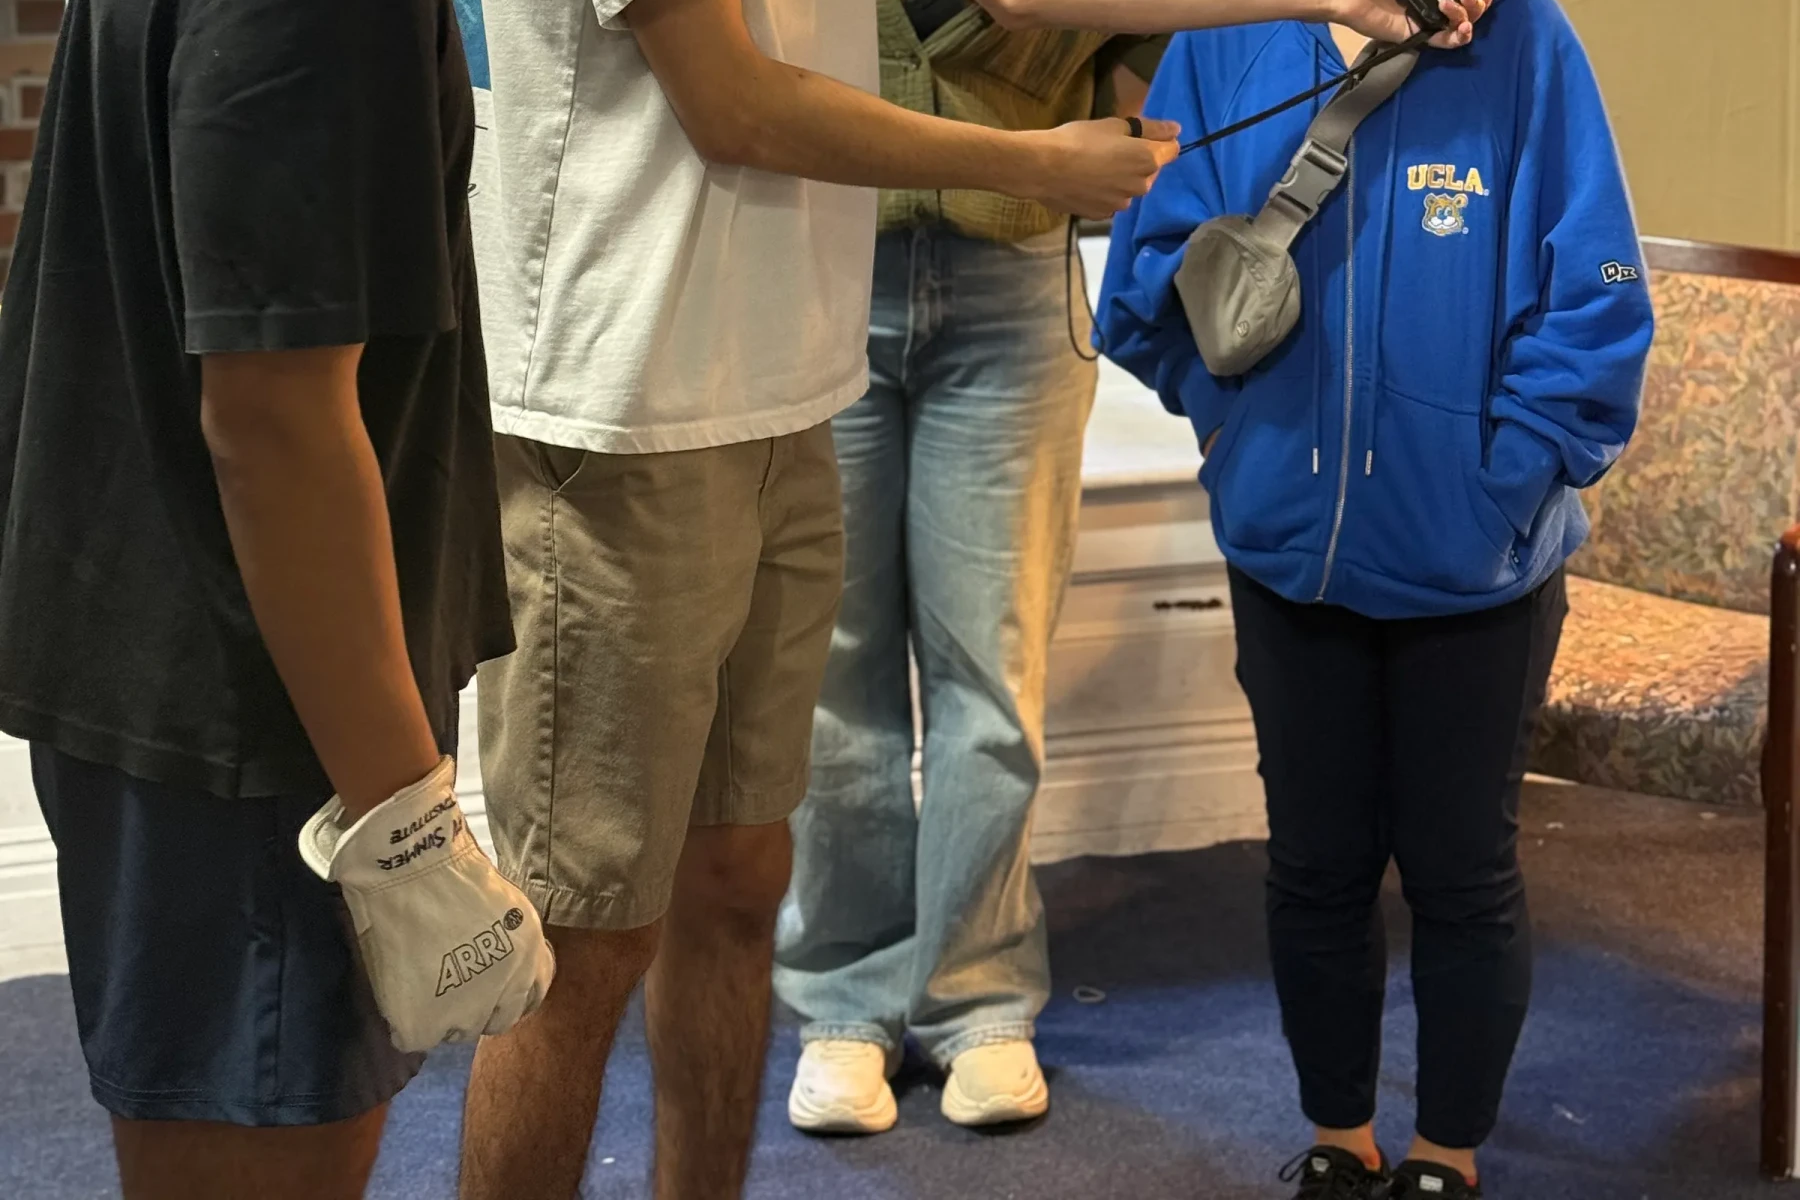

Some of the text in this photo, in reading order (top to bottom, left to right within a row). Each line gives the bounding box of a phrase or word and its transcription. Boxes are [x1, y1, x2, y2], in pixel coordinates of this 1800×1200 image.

[1407, 164, 1484, 195] UCLA
[389, 793, 457, 845] INSTITUTE
[377, 826, 446, 871] SUMMER
[435, 919, 514, 997] ARRI
